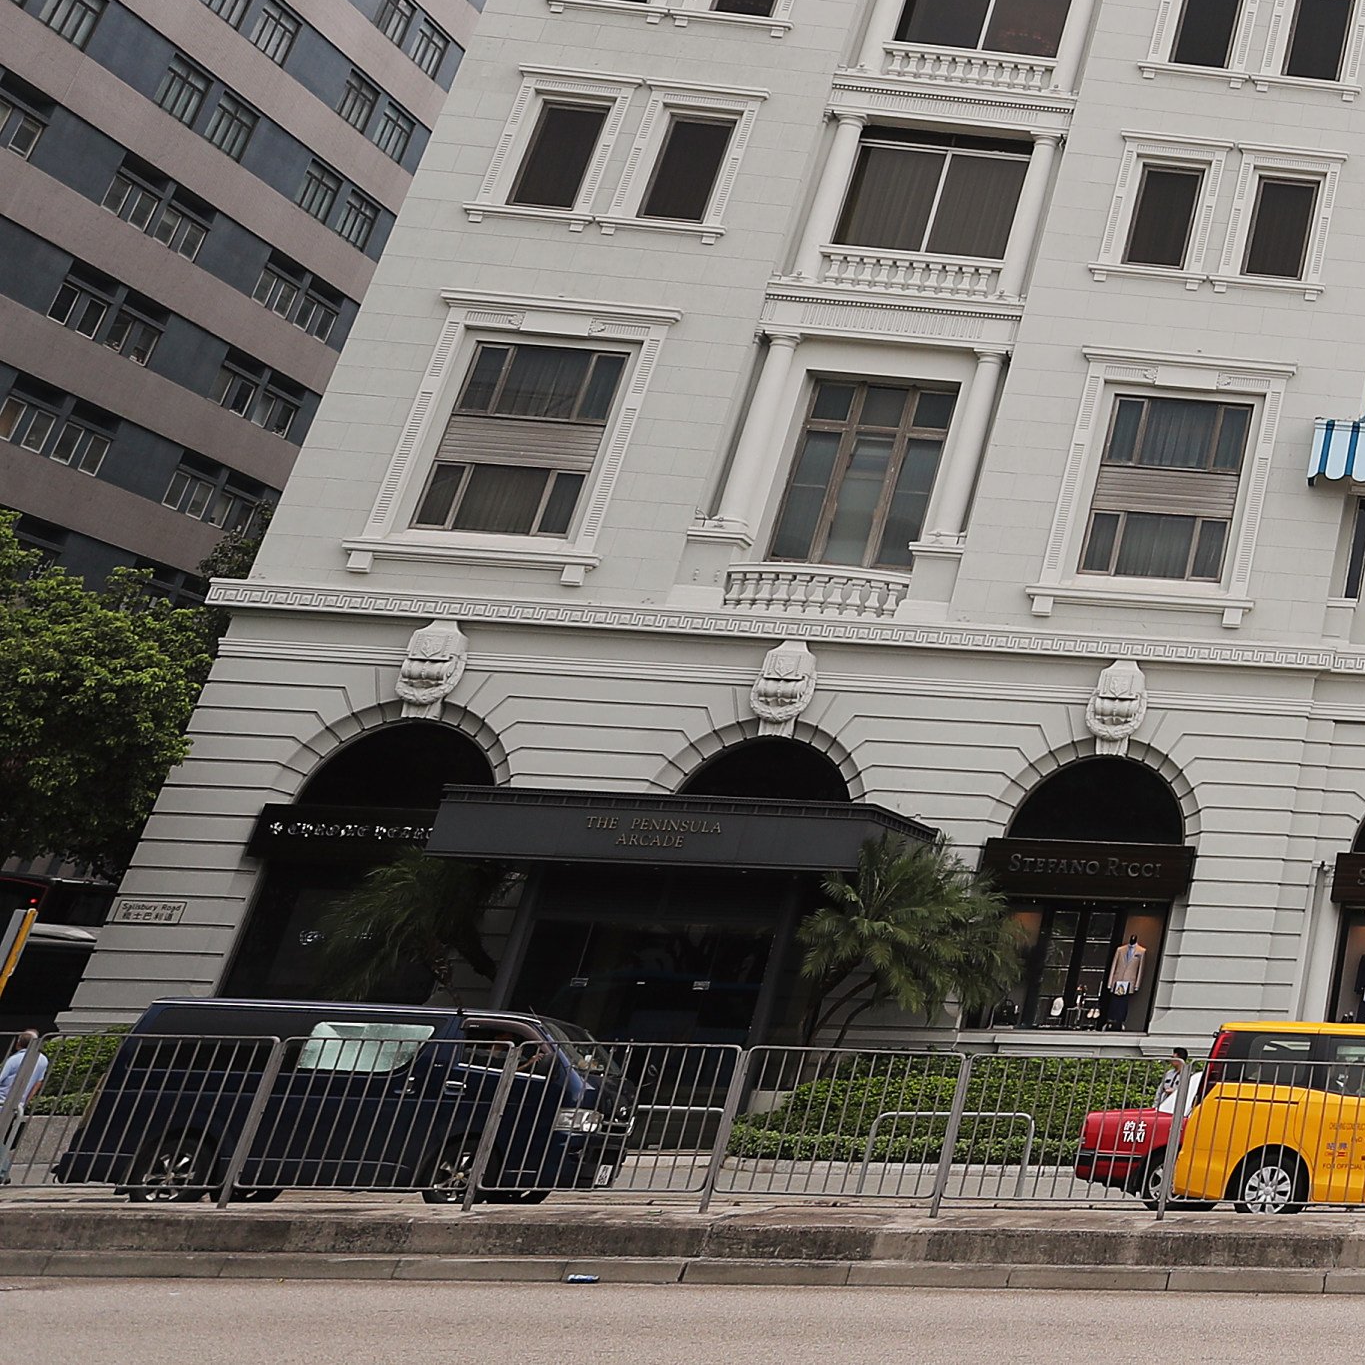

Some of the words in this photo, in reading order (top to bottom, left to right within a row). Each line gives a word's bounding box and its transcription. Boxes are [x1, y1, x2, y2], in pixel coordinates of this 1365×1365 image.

[586, 816, 619, 829] THE
[631, 817, 722, 833] PENINSULA
[616, 833, 685, 848] ARCADE
[122, 903, 159, 912] Salisbury
[161, 904, 182, 913] Road
[1123, 1120, 1147, 1131] 的士
[1123, 1131, 1145, 1143] TAXI
